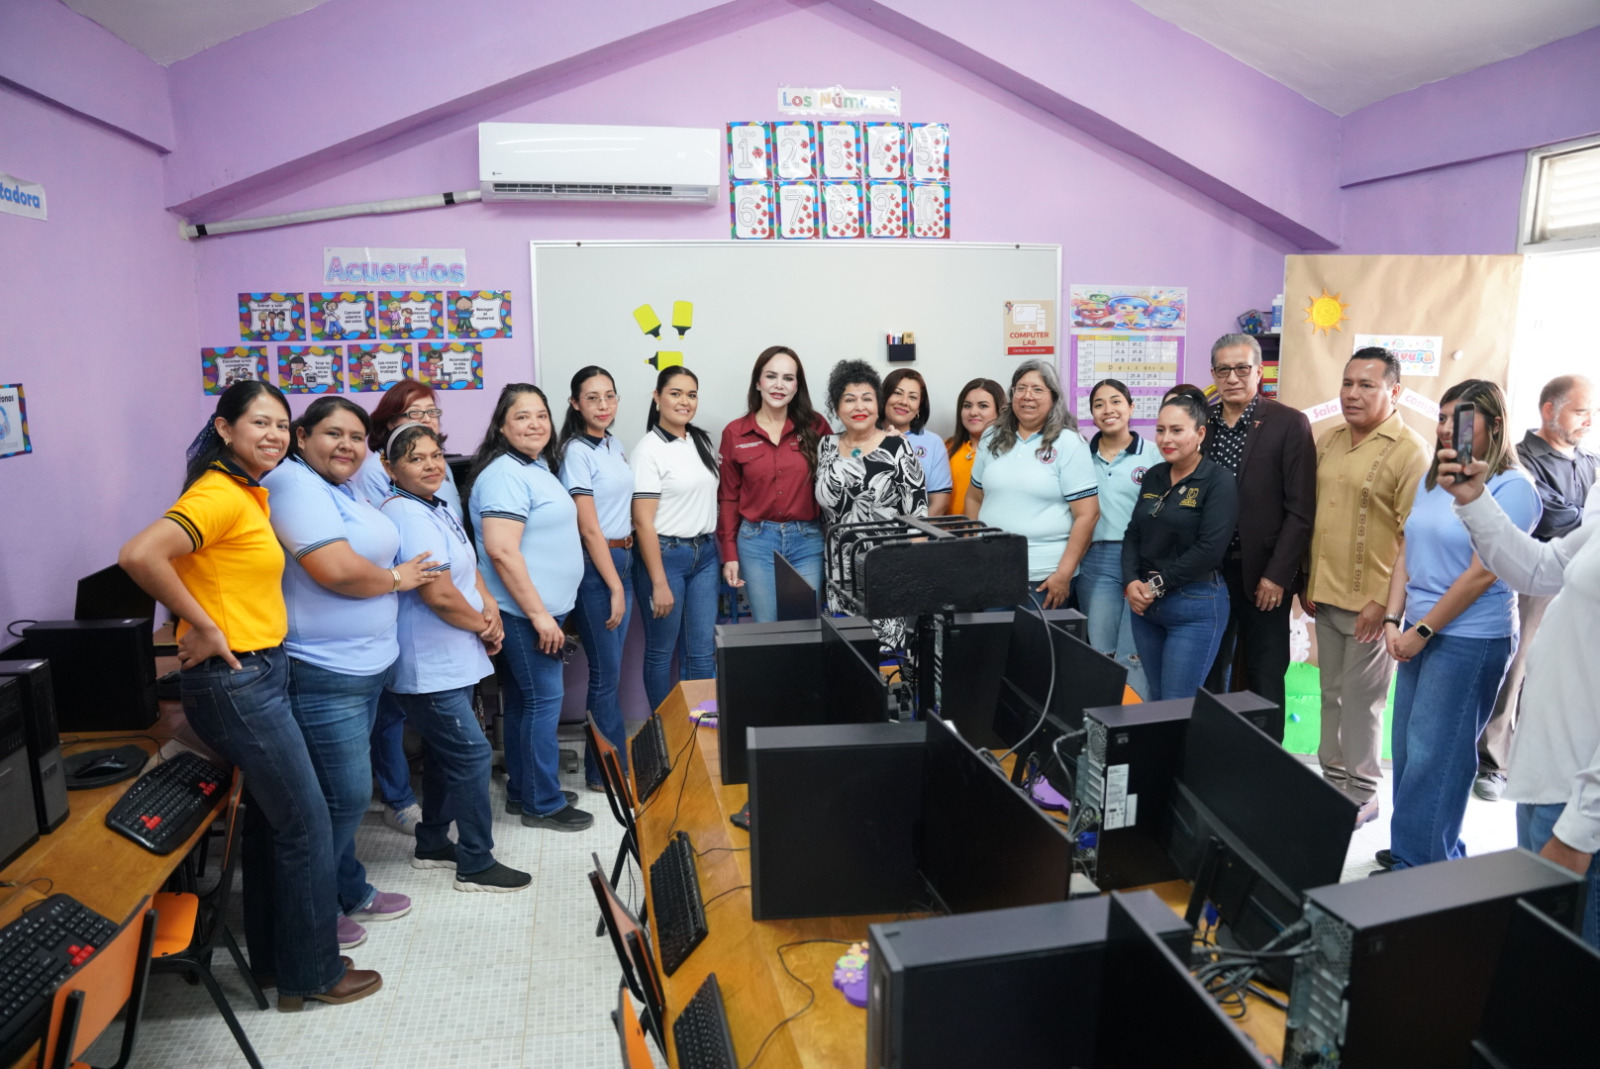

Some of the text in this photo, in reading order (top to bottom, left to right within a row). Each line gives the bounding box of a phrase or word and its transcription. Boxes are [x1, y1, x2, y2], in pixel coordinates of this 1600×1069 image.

[782, 91, 812, 108] Los
[737, 138, 754, 169] 1
[780, 138, 799, 169] 2
[827, 138, 844, 169] 3
[872, 135, 887, 166] 4
[915, 136, 933, 166] 5
[737, 197, 758, 228] 6
[784, 194, 804, 227] 7
[829, 194, 847, 225] 8
[873, 193, 890, 223] 9
[915, 195, 935, 227] 10
[325, 255, 465, 284] Acuerdos
[0, 394, 14, 403] onos
[1313, 403, 1339, 419] Sala
